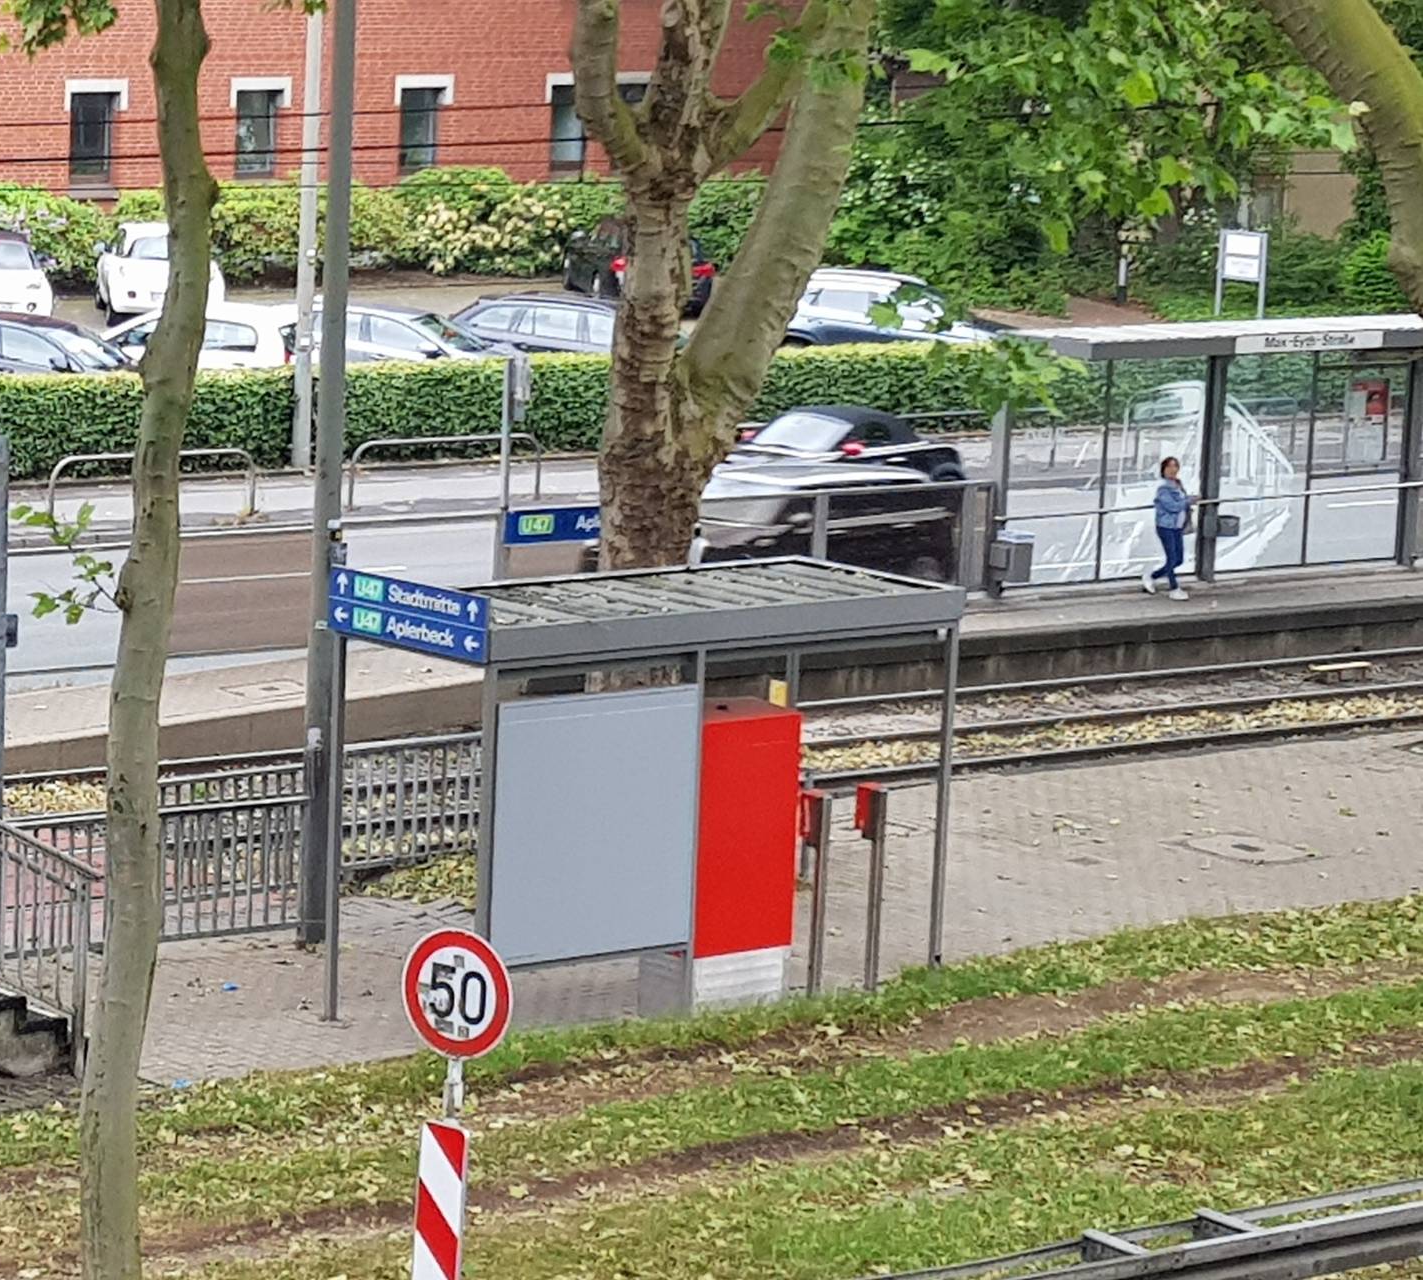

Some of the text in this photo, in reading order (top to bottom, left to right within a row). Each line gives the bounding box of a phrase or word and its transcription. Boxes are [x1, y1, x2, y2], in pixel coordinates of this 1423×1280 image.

[524, 516, 552, 532] U47
[355, 576, 461, 616] U47 Stadtmitte
[354, 608, 455, 648] U47 Aplerbeck
[428, 961, 487, 1026] 50
